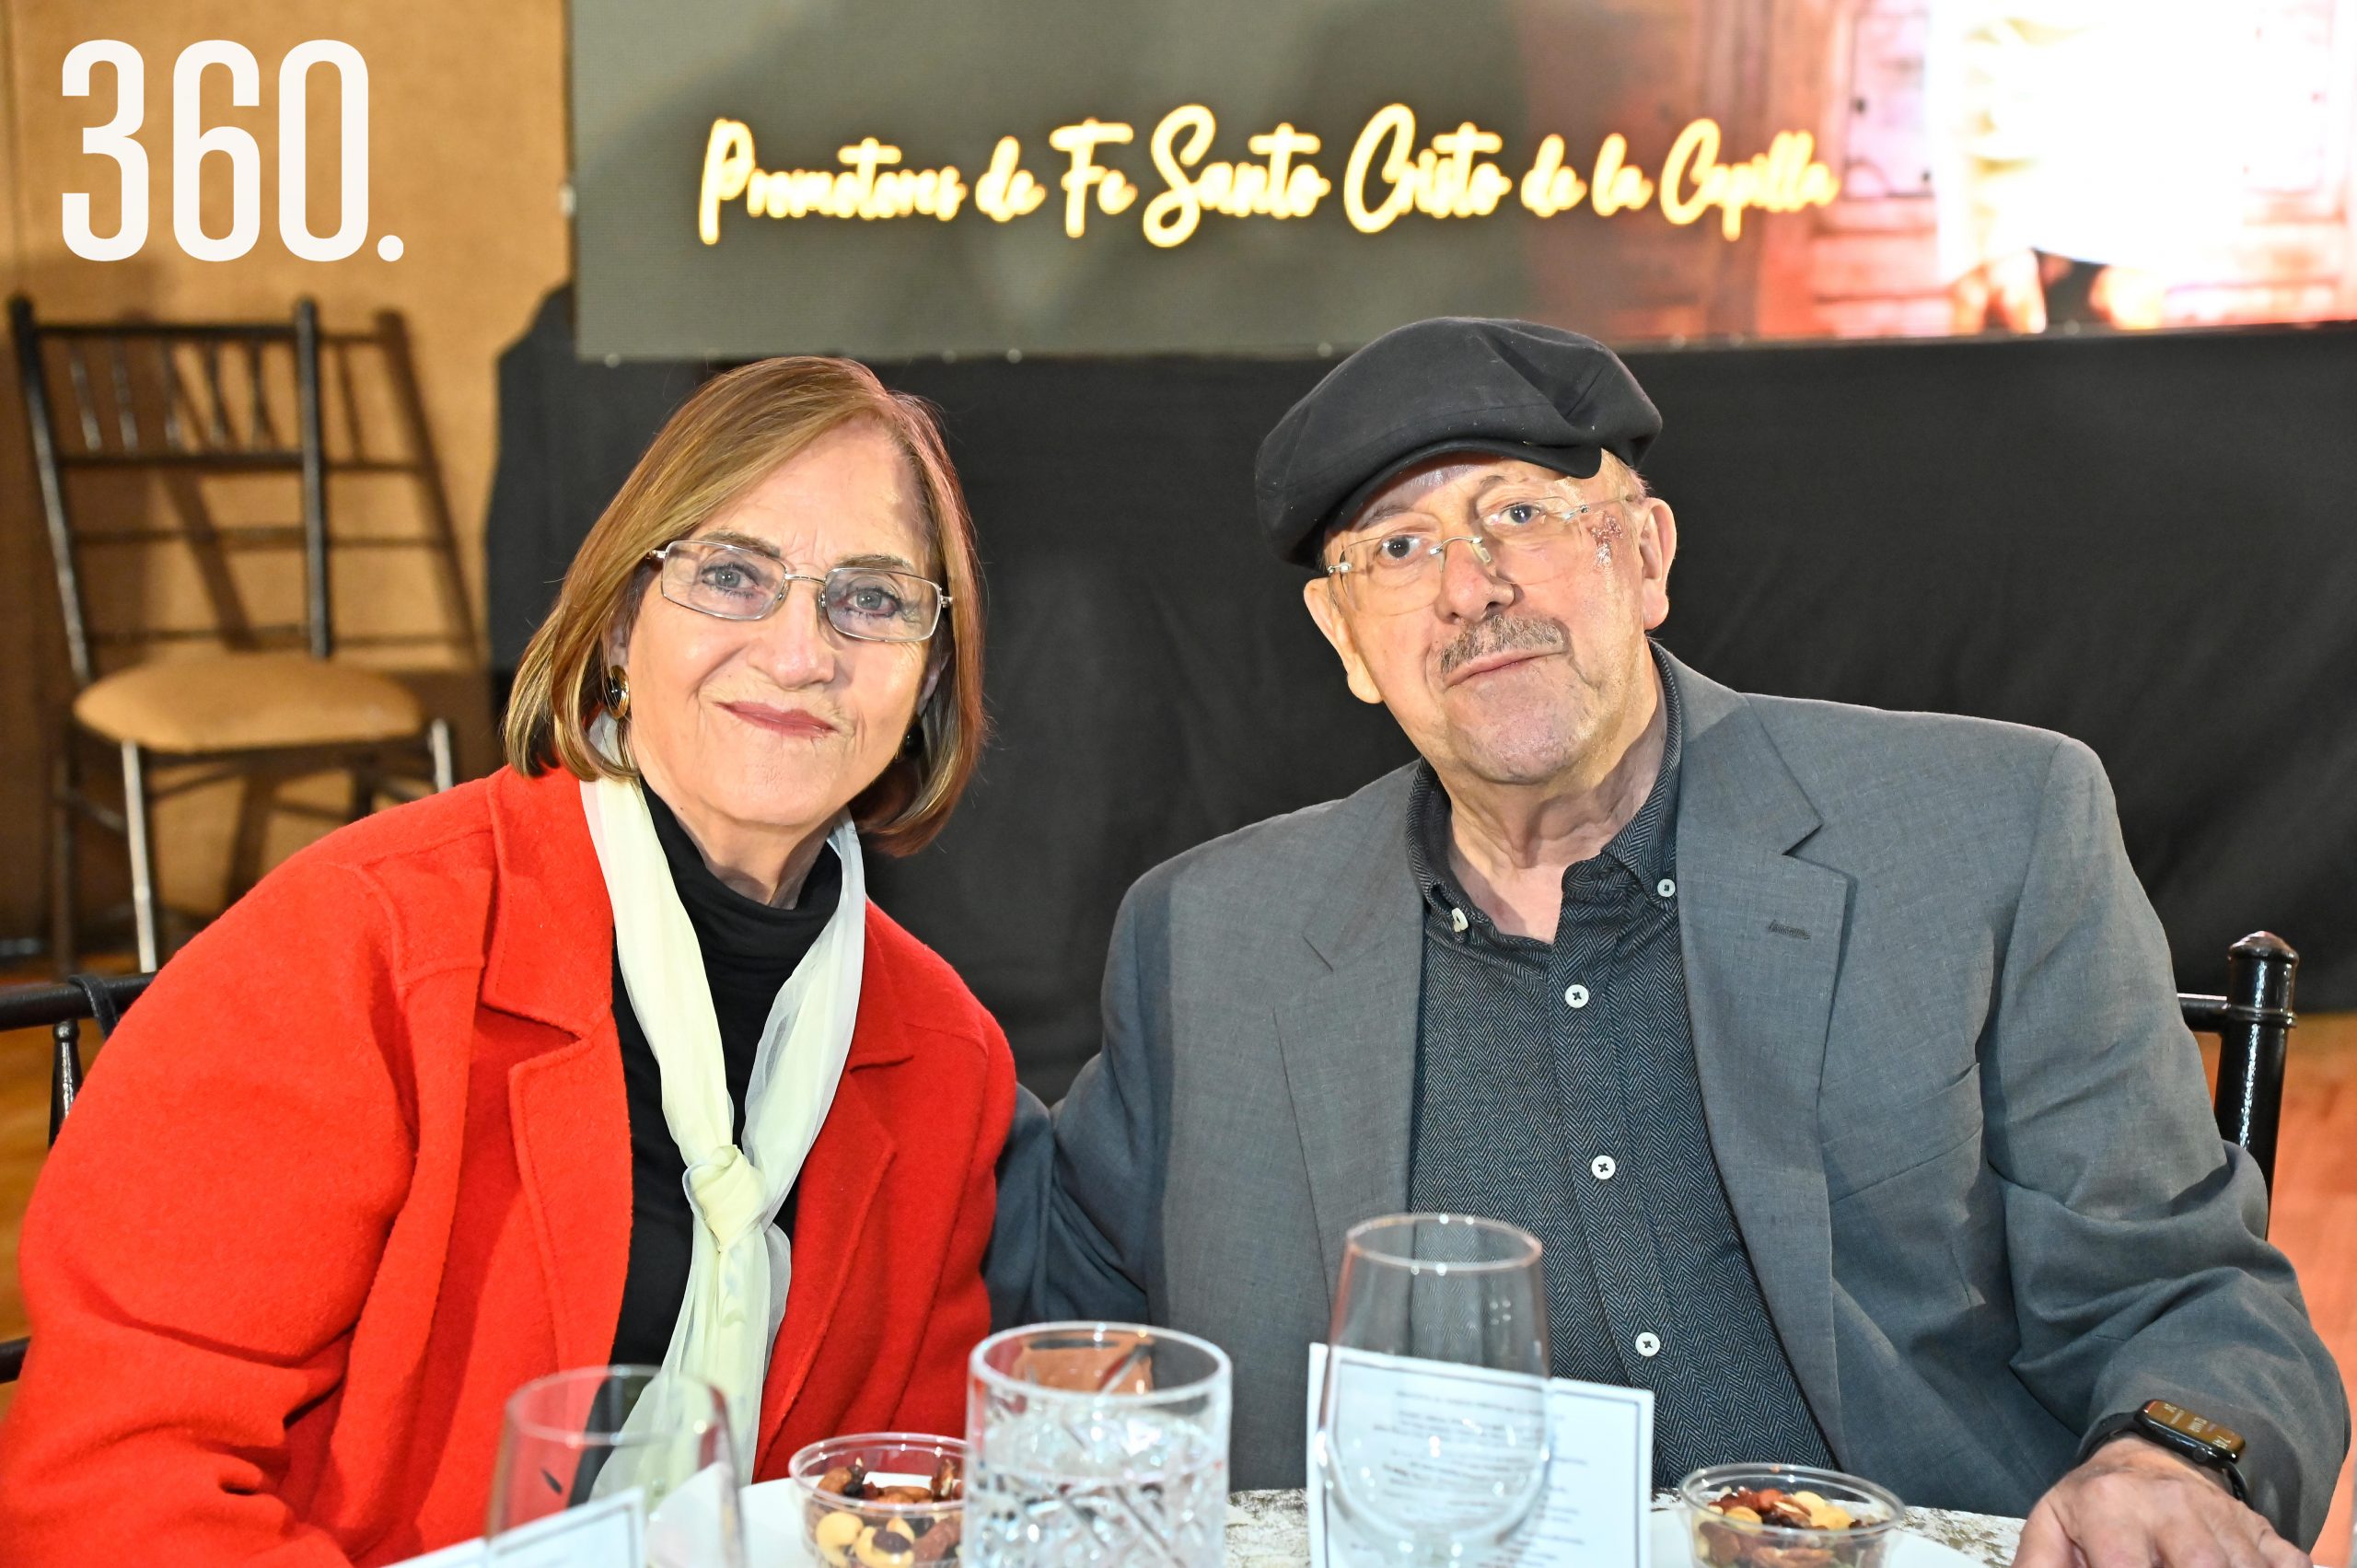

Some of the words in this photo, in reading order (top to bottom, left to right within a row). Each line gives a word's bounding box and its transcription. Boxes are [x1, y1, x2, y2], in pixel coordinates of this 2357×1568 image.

[698, 118, 967, 245] Promotores
[975, 135, 1046, 223] de
[1049, 117, 1138, 238] Fe
[1144, 103, 1331, 248] Santo
[1343, 102, 1513, 234] Cristo
[1520, 133, 1587, 218] de
[1591, 132, 1654, 217] la
[1659, 118, 1840, 240] Capilla
